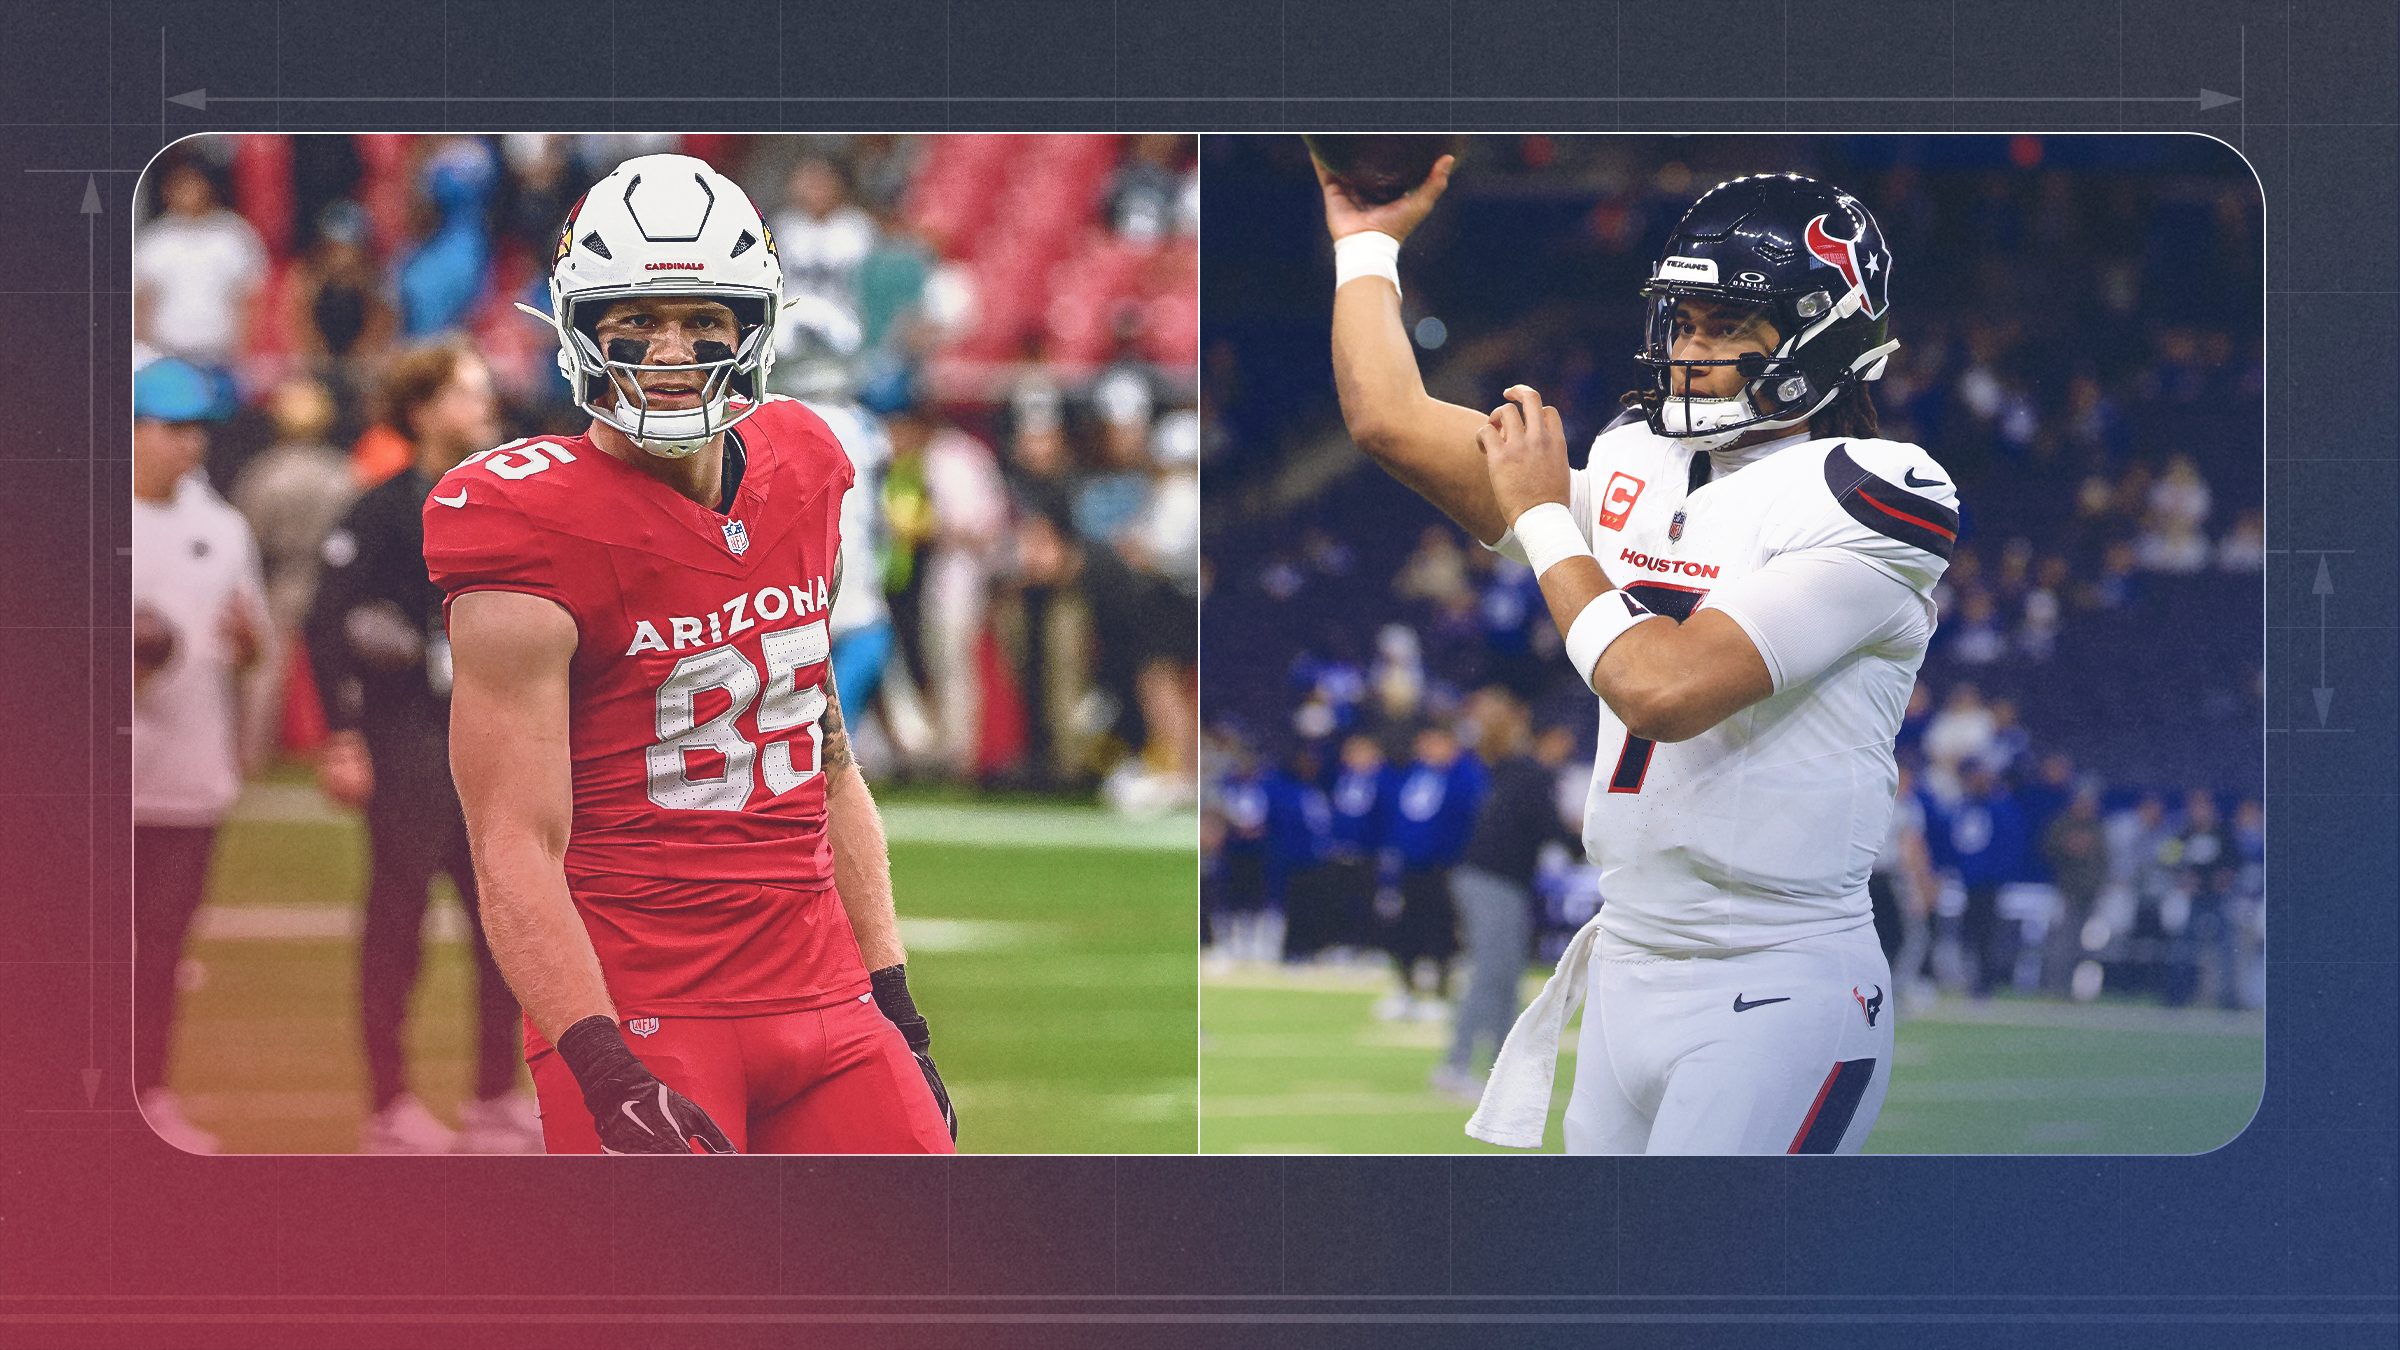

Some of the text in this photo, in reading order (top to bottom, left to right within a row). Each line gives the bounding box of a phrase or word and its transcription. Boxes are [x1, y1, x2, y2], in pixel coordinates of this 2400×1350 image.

[645, 262, 704, 270] CARDINALS
[1666, 260, 1709, 271] TEXANS
[1732, 280, 1771, 290] OAKLEY
[1604, 475, 1638, 516] C
[1620, 548, 1720, 579] HOUSTON
[625, 576, 829, 656] ARIZONA
[646, 619, 830, 812] 85
